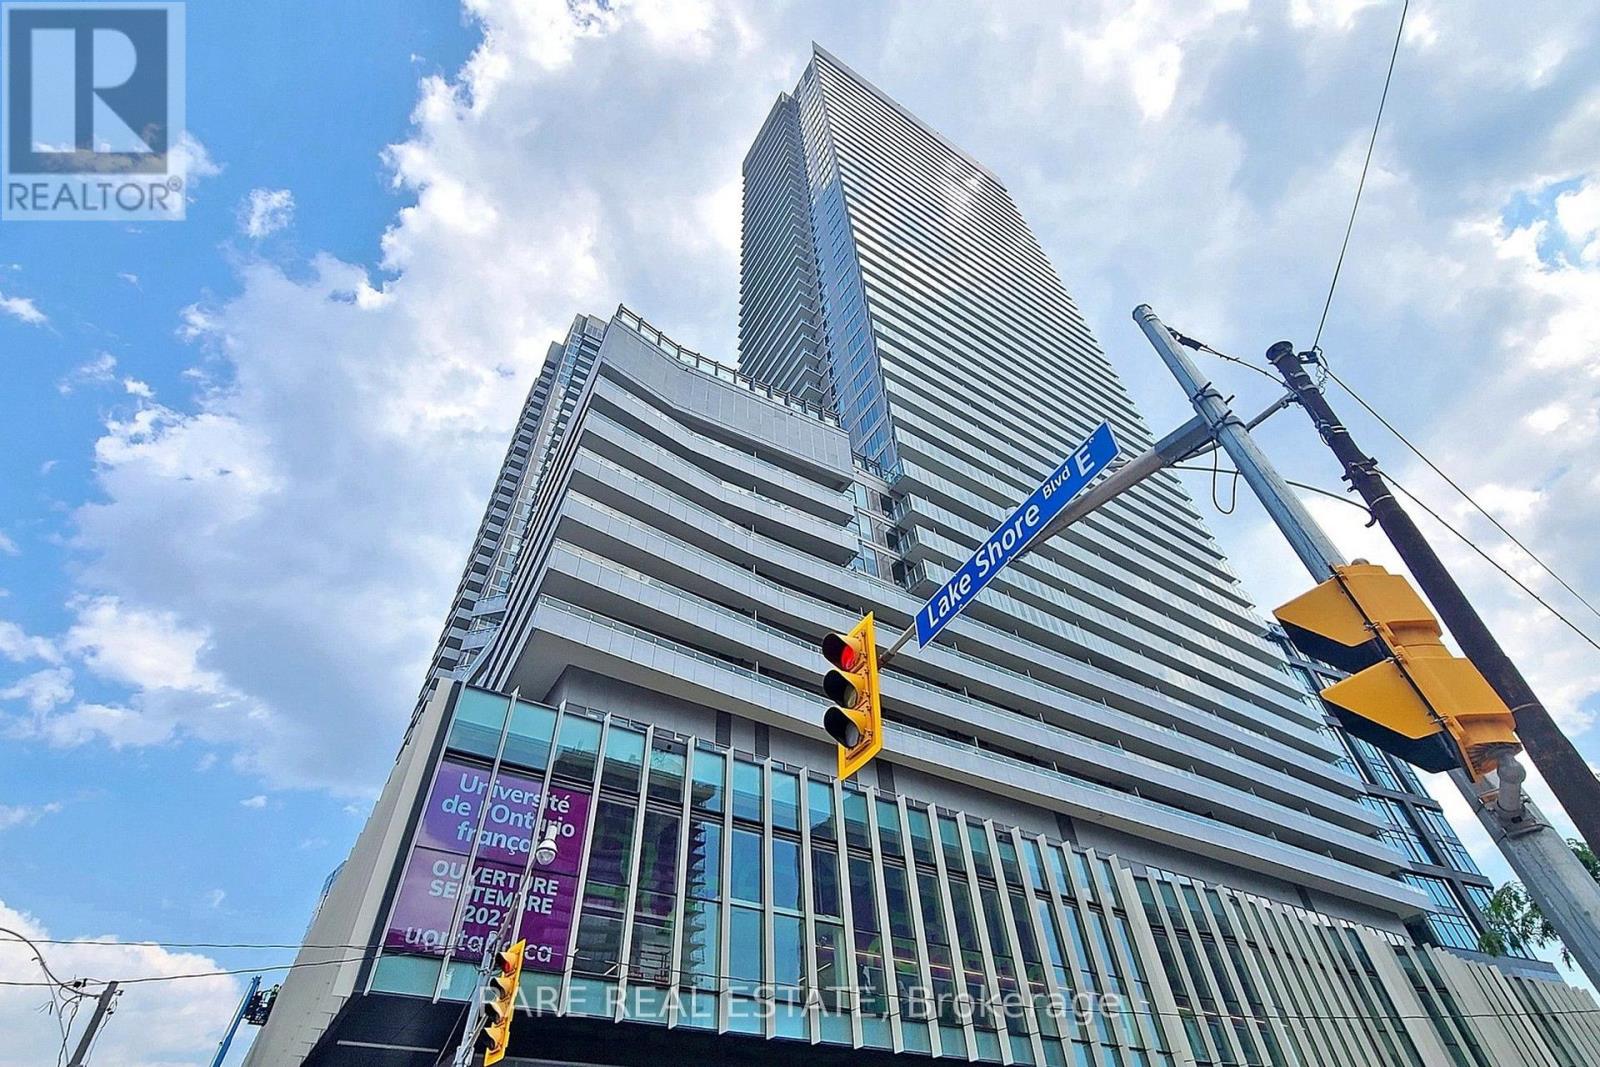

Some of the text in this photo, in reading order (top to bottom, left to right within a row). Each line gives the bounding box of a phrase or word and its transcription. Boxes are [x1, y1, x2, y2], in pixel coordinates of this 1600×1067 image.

[926, 444, 1096, 629] Lake Shore Blvd E
[441, 794, 472, 816] de
[457, 820, 533, 856] frança
[431, 879, 554, 915] SETEMRE
